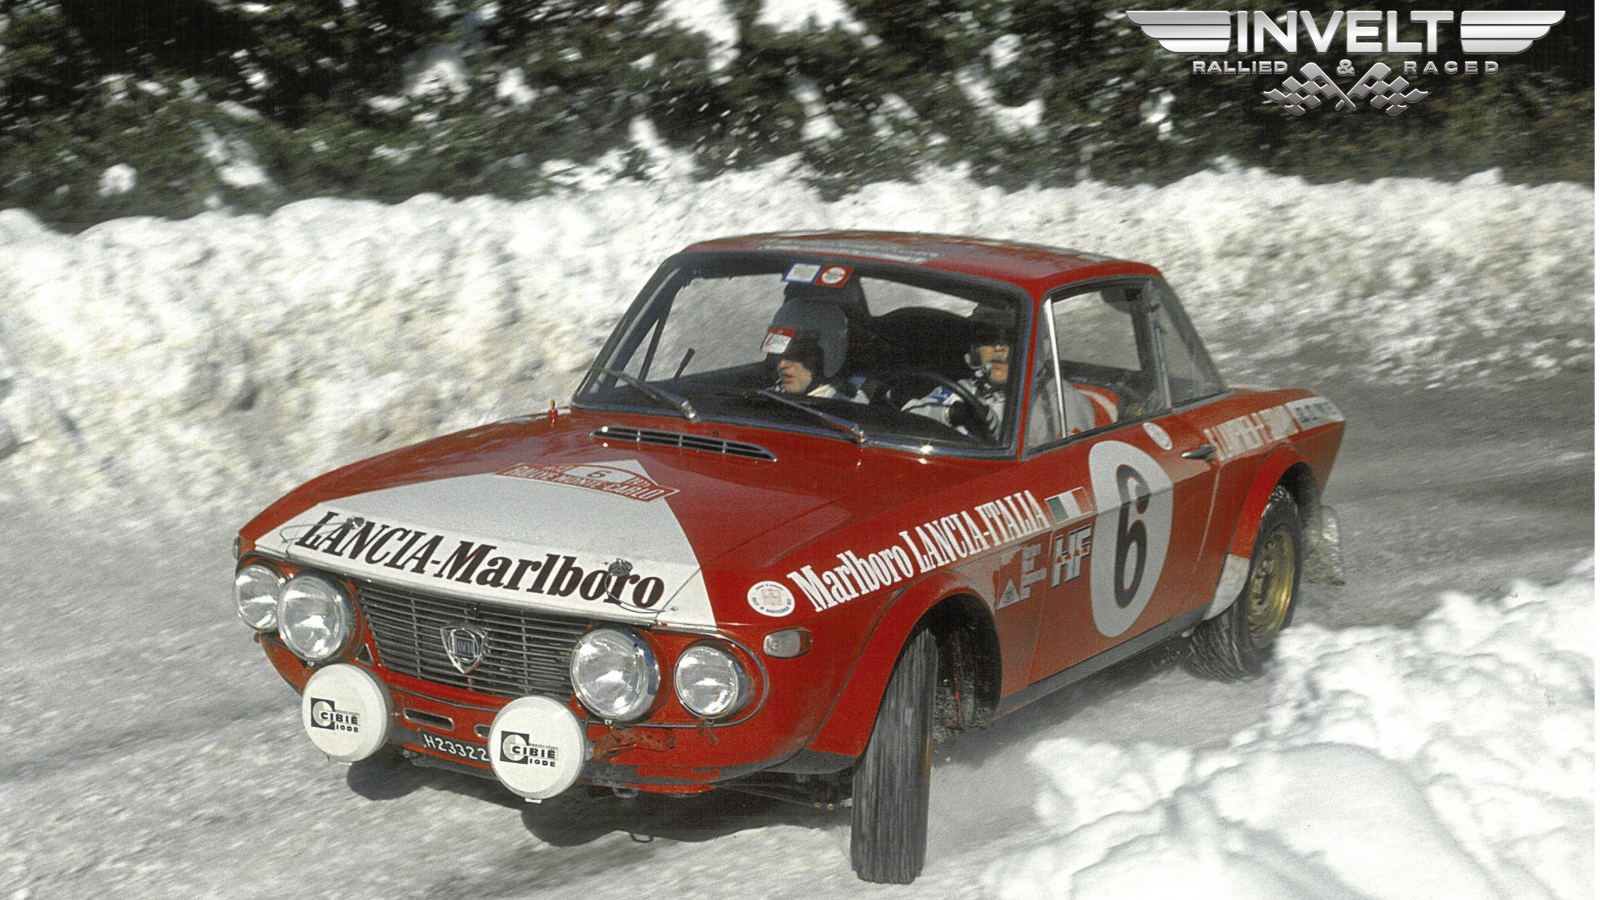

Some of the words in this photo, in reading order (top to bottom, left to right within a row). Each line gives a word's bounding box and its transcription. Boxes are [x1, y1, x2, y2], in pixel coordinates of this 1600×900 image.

[1114, 463, 1152, 610] 6
[787, 544, 914, 613] Marlboro
[336, 724, 359, 733] IODE
[423, 734, 491, 762] H23322
[529, 758, 556, 768] IODE
